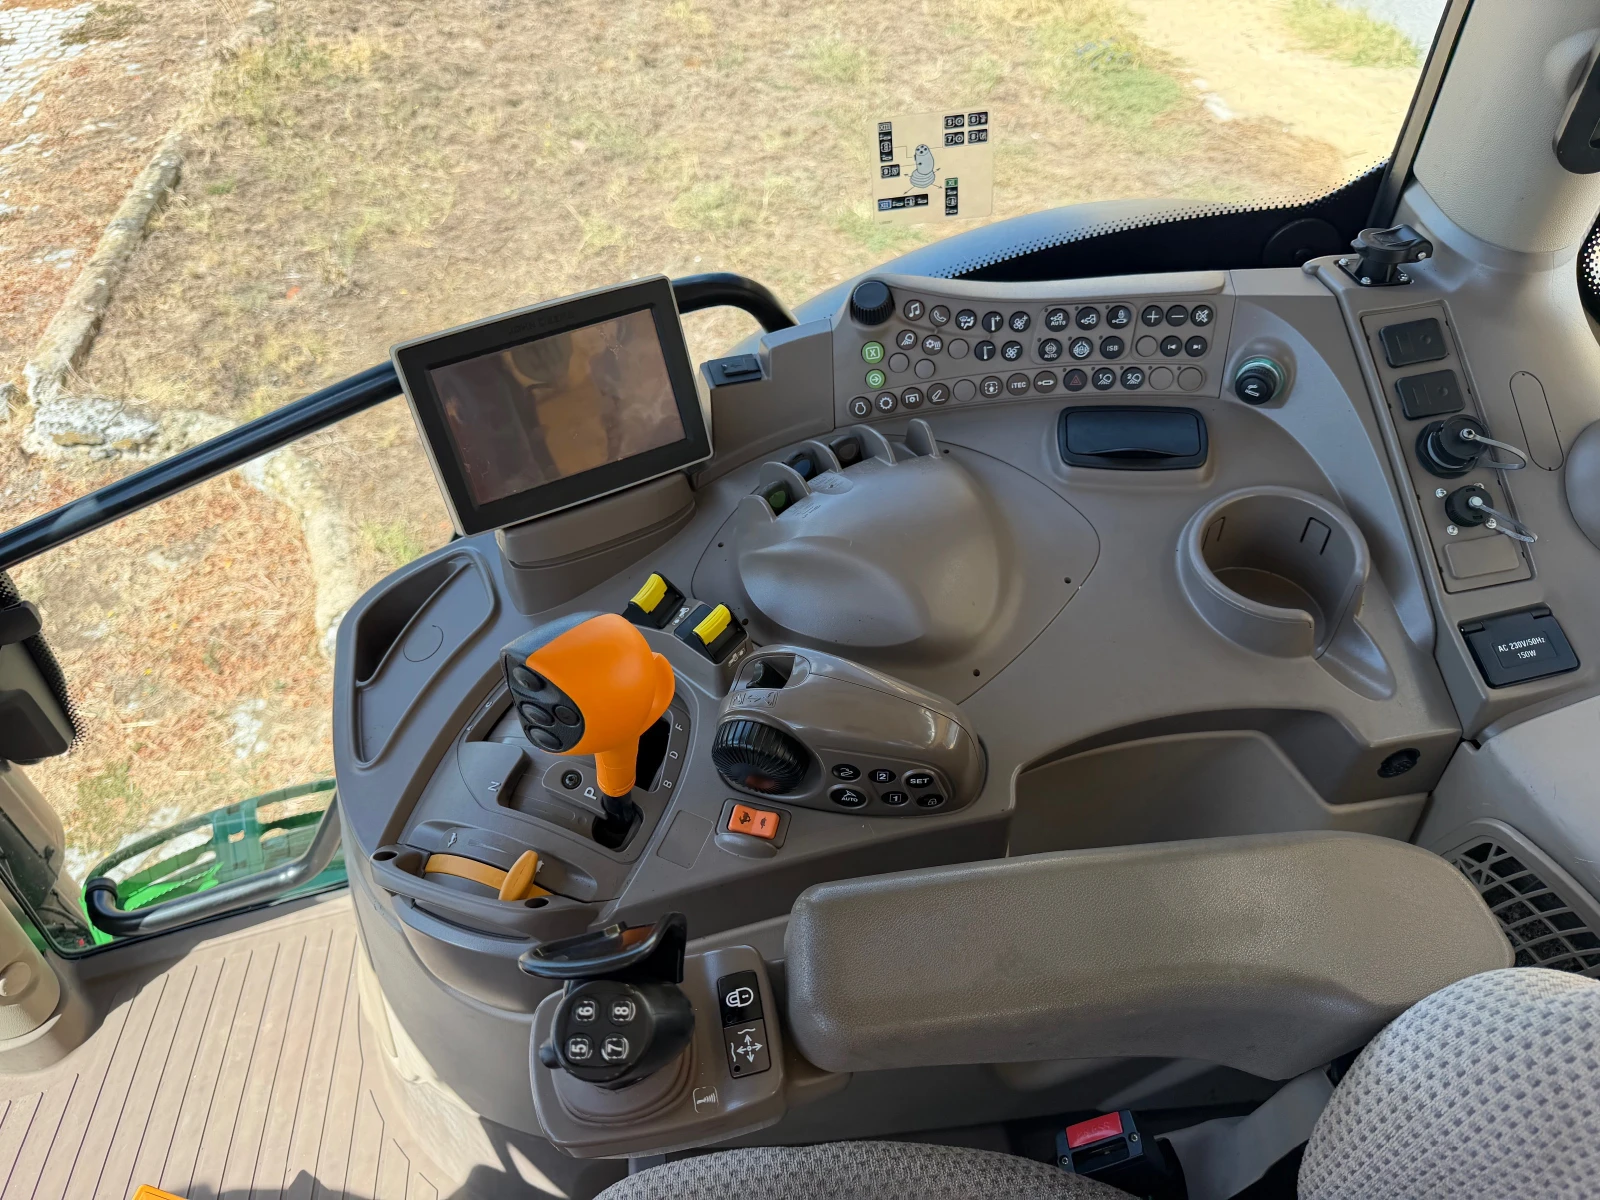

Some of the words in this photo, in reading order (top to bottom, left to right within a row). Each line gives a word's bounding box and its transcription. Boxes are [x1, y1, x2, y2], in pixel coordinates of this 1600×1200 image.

[1498, 644, 1508, 652] AC
[1509, 637, 1545, 650] 230V/50Hz
[1517, 649, 1537, 659] 150W
[675, 723, 683, 731] F
[669, 750, 679, 760] D
[487, 780, 501, 792] N
[662, 779, 673, 789] B
[583, 786, 598, 801] P
[578, 1006, 593, 1016] 6
[614, 1006, 629, 1016] 8
[571, 1044, 587, 1053] 5
[607, 1043, 623, 1053] 7
